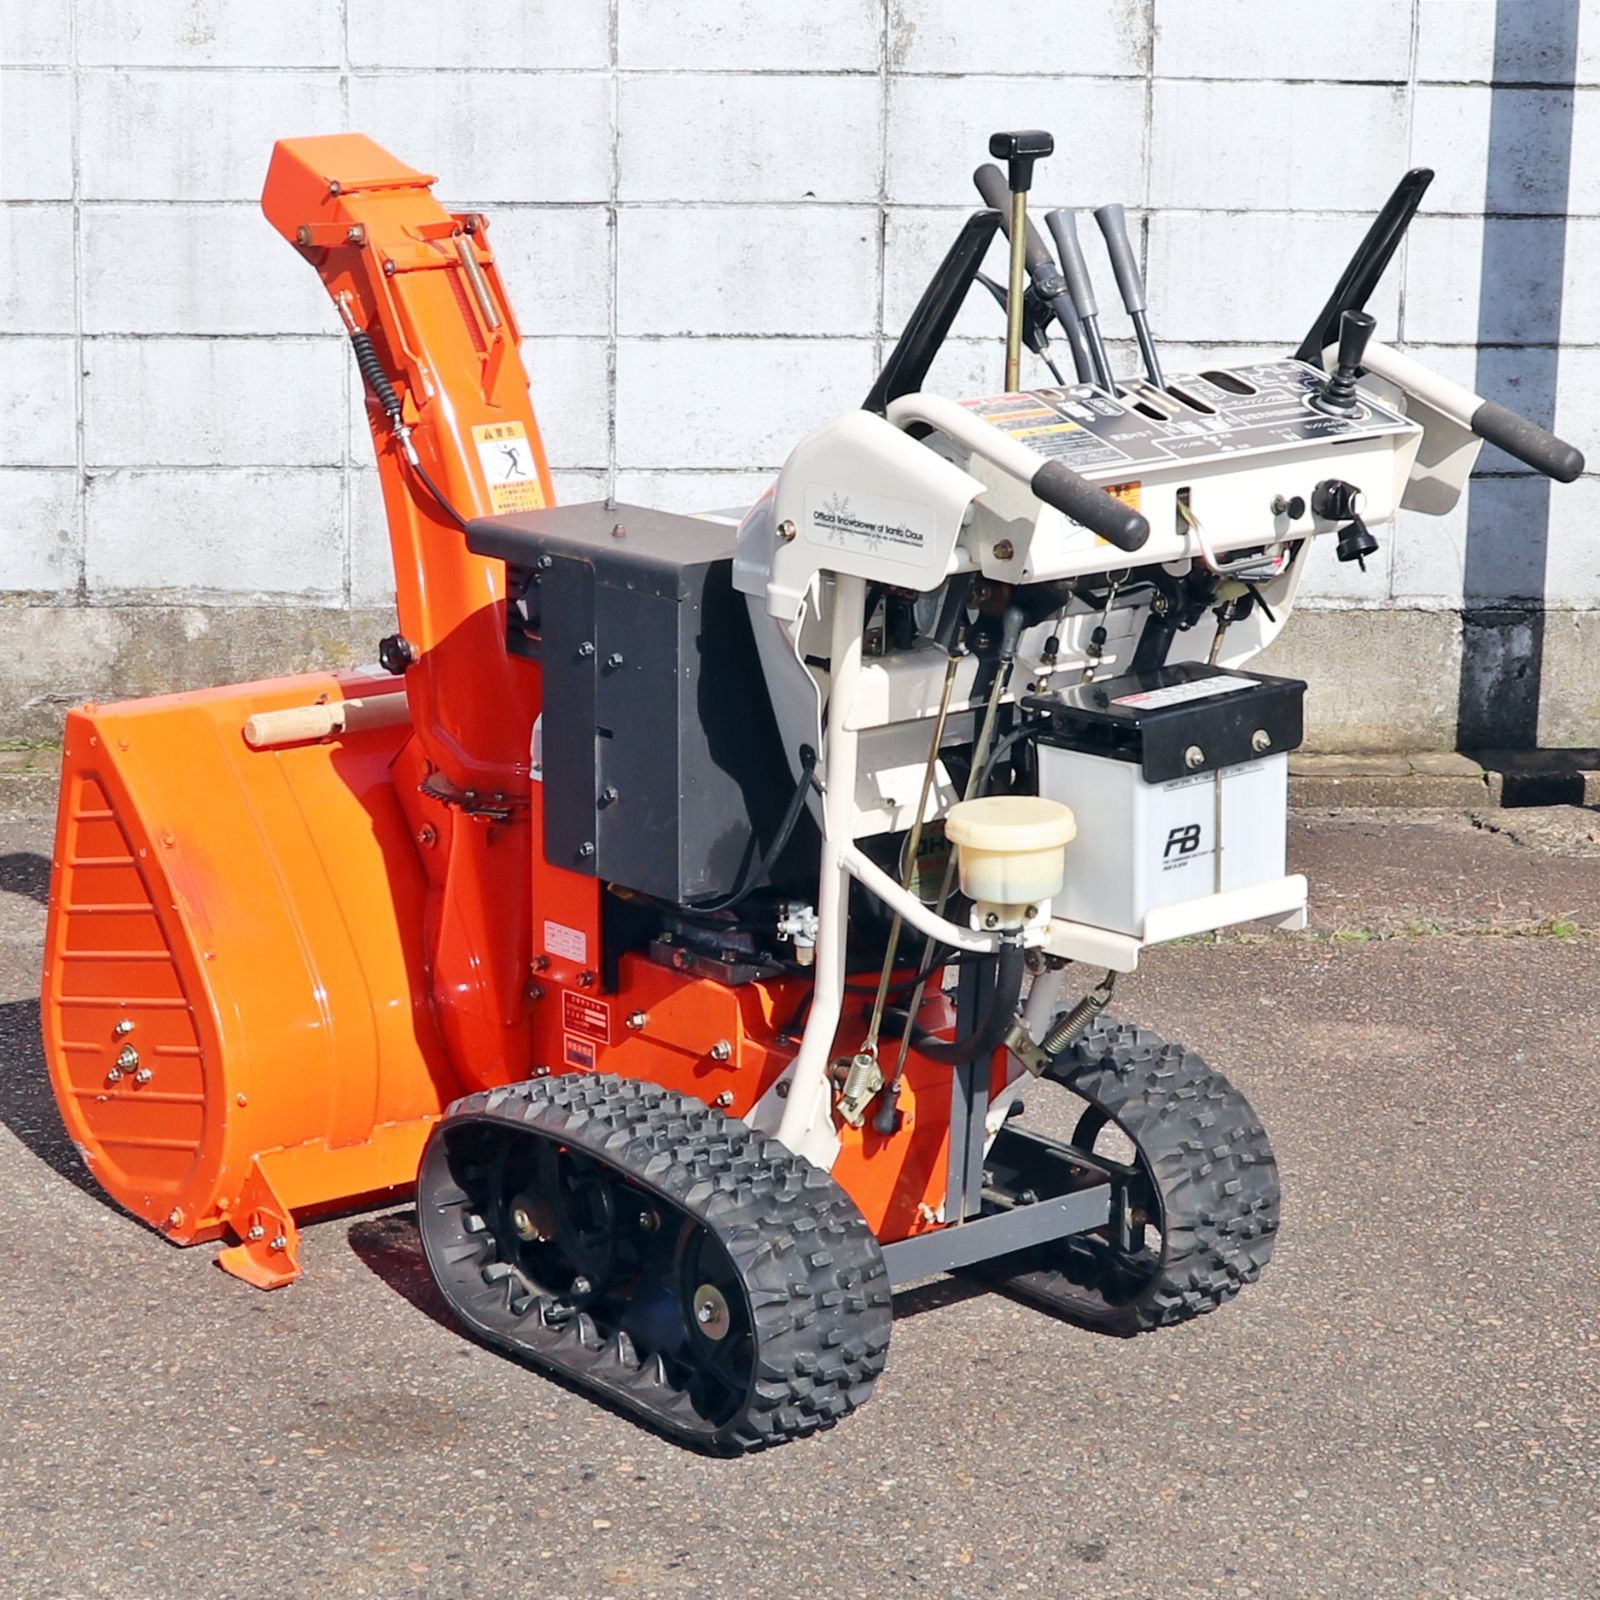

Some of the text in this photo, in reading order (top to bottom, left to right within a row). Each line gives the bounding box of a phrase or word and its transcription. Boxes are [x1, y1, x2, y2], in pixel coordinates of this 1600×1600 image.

[813, 510, 836, 523] Official
[885, 525, 903, 537] Santa
[904, 529, 924, 541] Claus
[1163, 823, 1201, 858] FB
